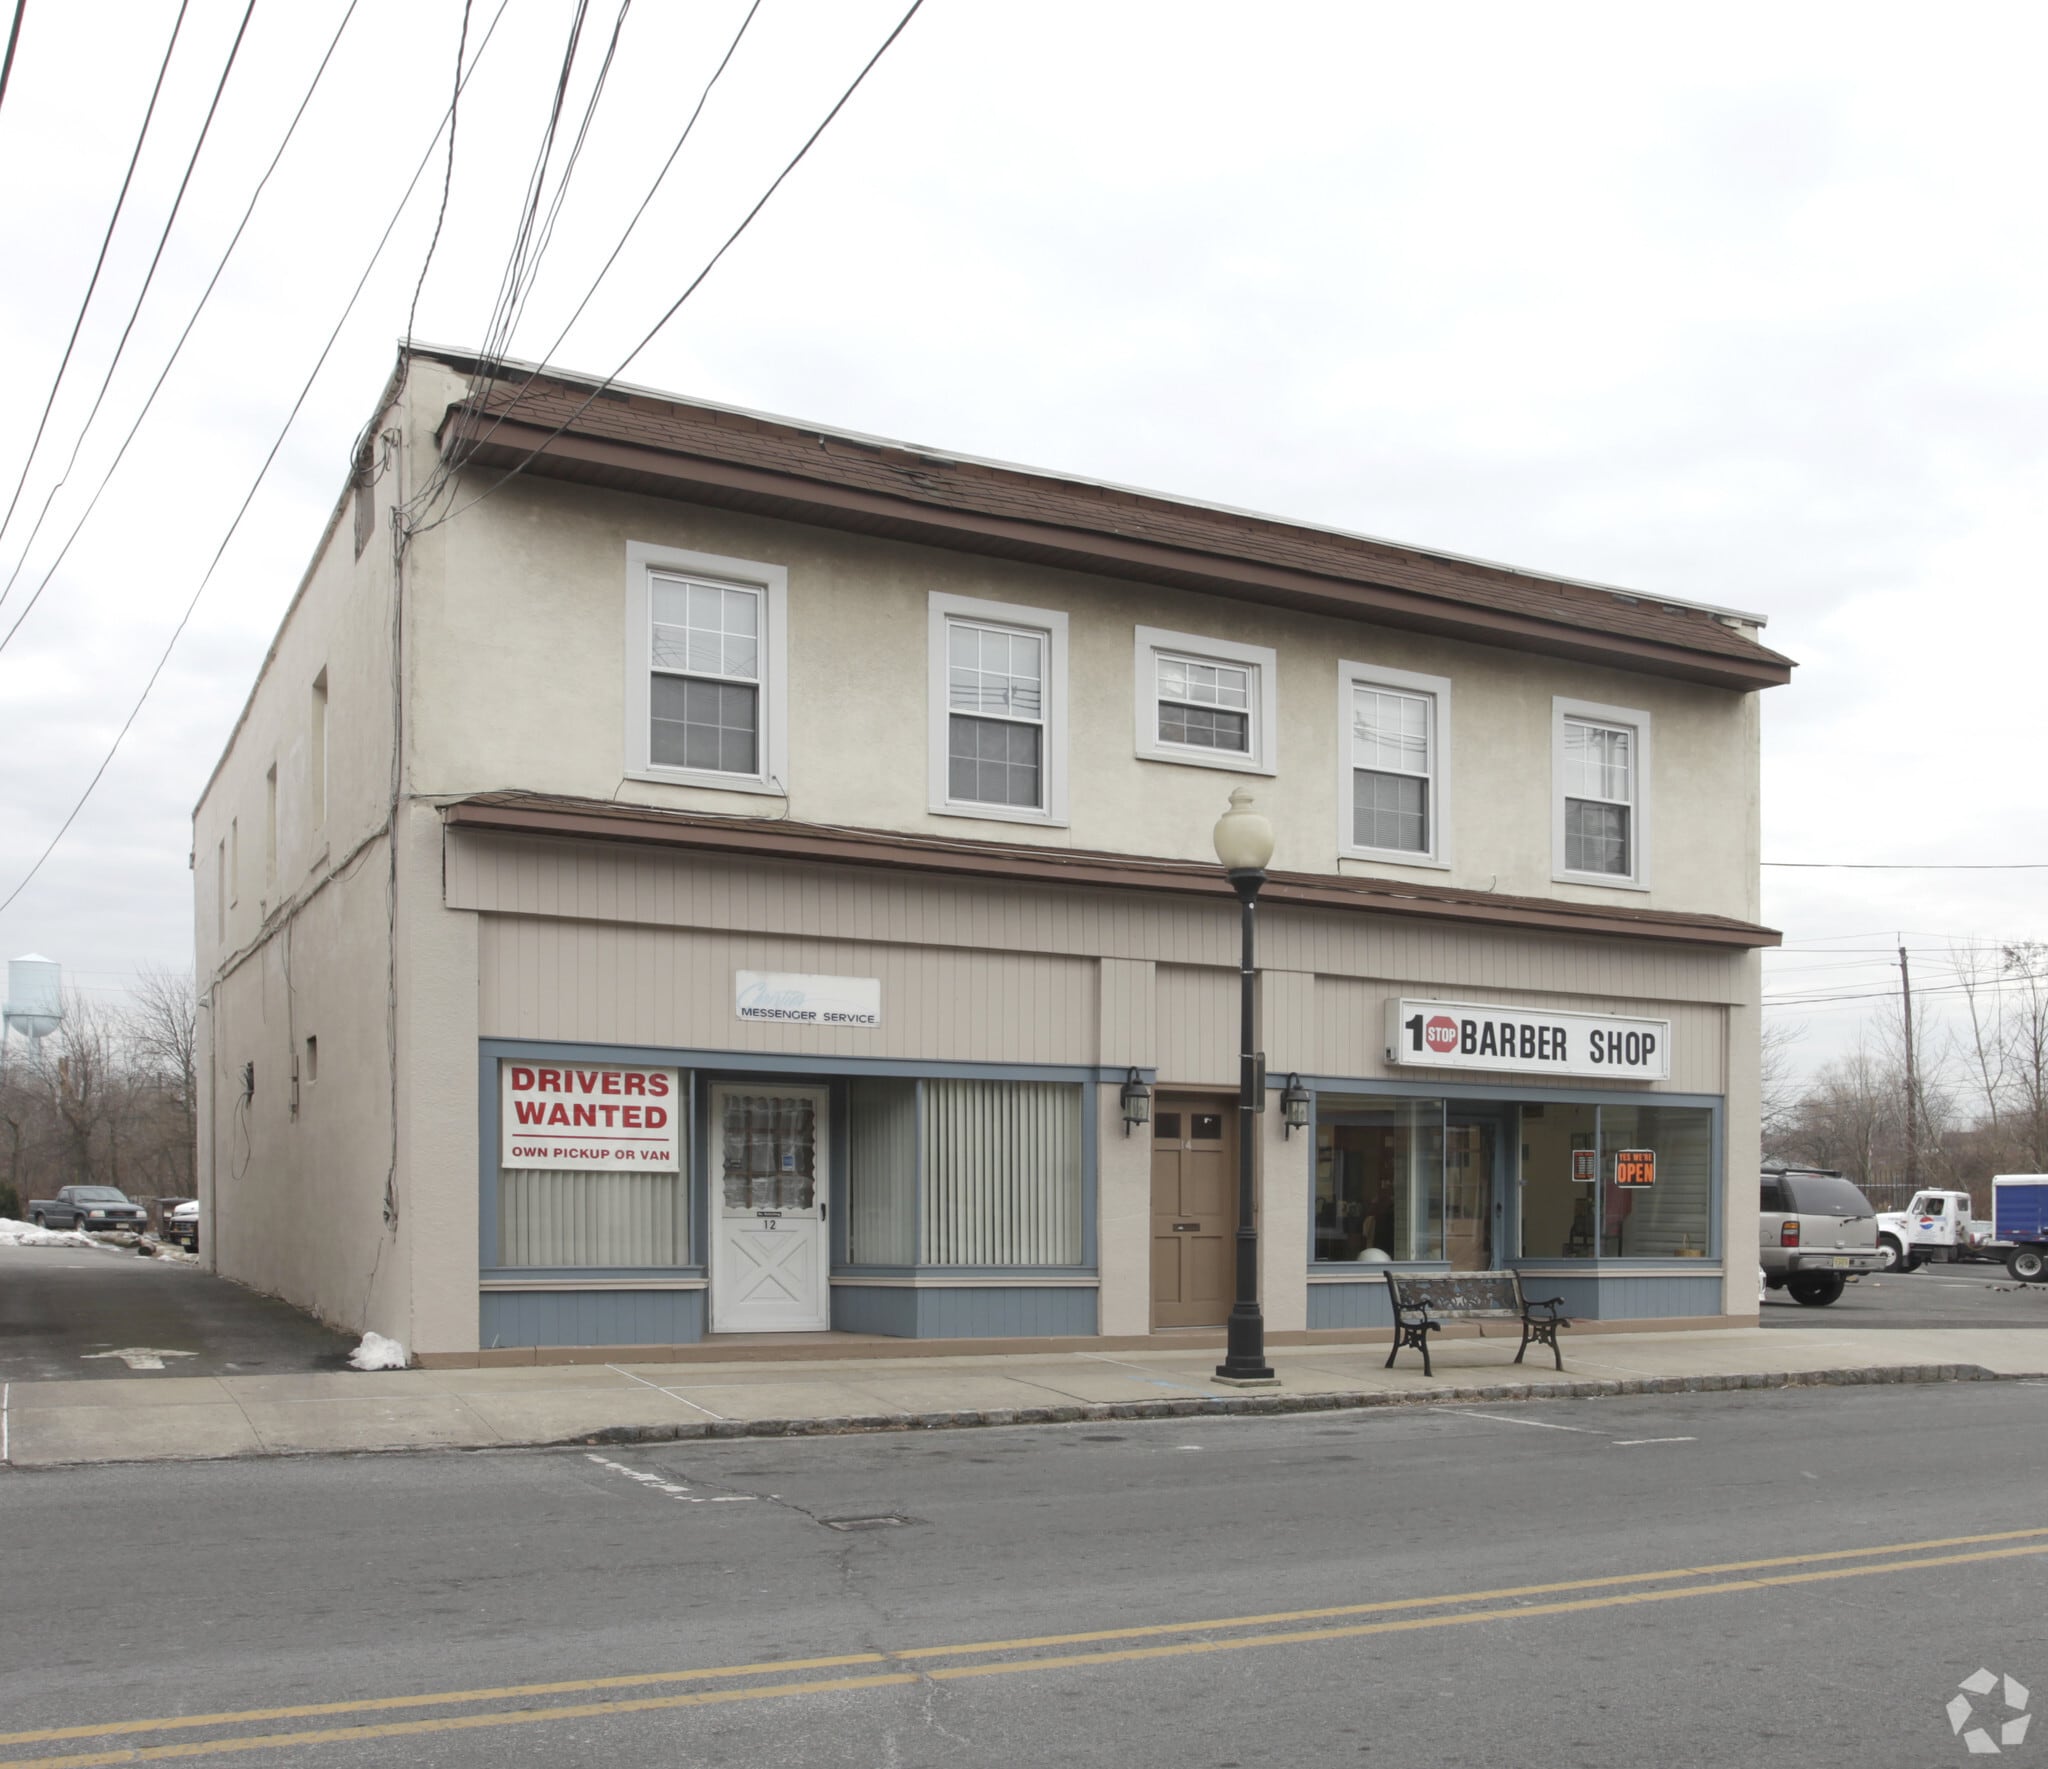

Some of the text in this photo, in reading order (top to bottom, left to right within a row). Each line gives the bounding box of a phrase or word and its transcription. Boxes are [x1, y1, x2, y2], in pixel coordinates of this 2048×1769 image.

[741, 1007, 875, 1023] MESSENGER SERVICE
[1405, 1014, 1656, 1066] 1 STOP BARBER SHOP
[511, 1067, 669, 1097] DRIVERS
[514, 1101, 668, 1129] WANTED
[512, 1146, 670, 1161] OWN PICKUP OR VAN
[1617, 1163, 1653, 1183] OPEN
[764, 1219, 777, 1230] 12
